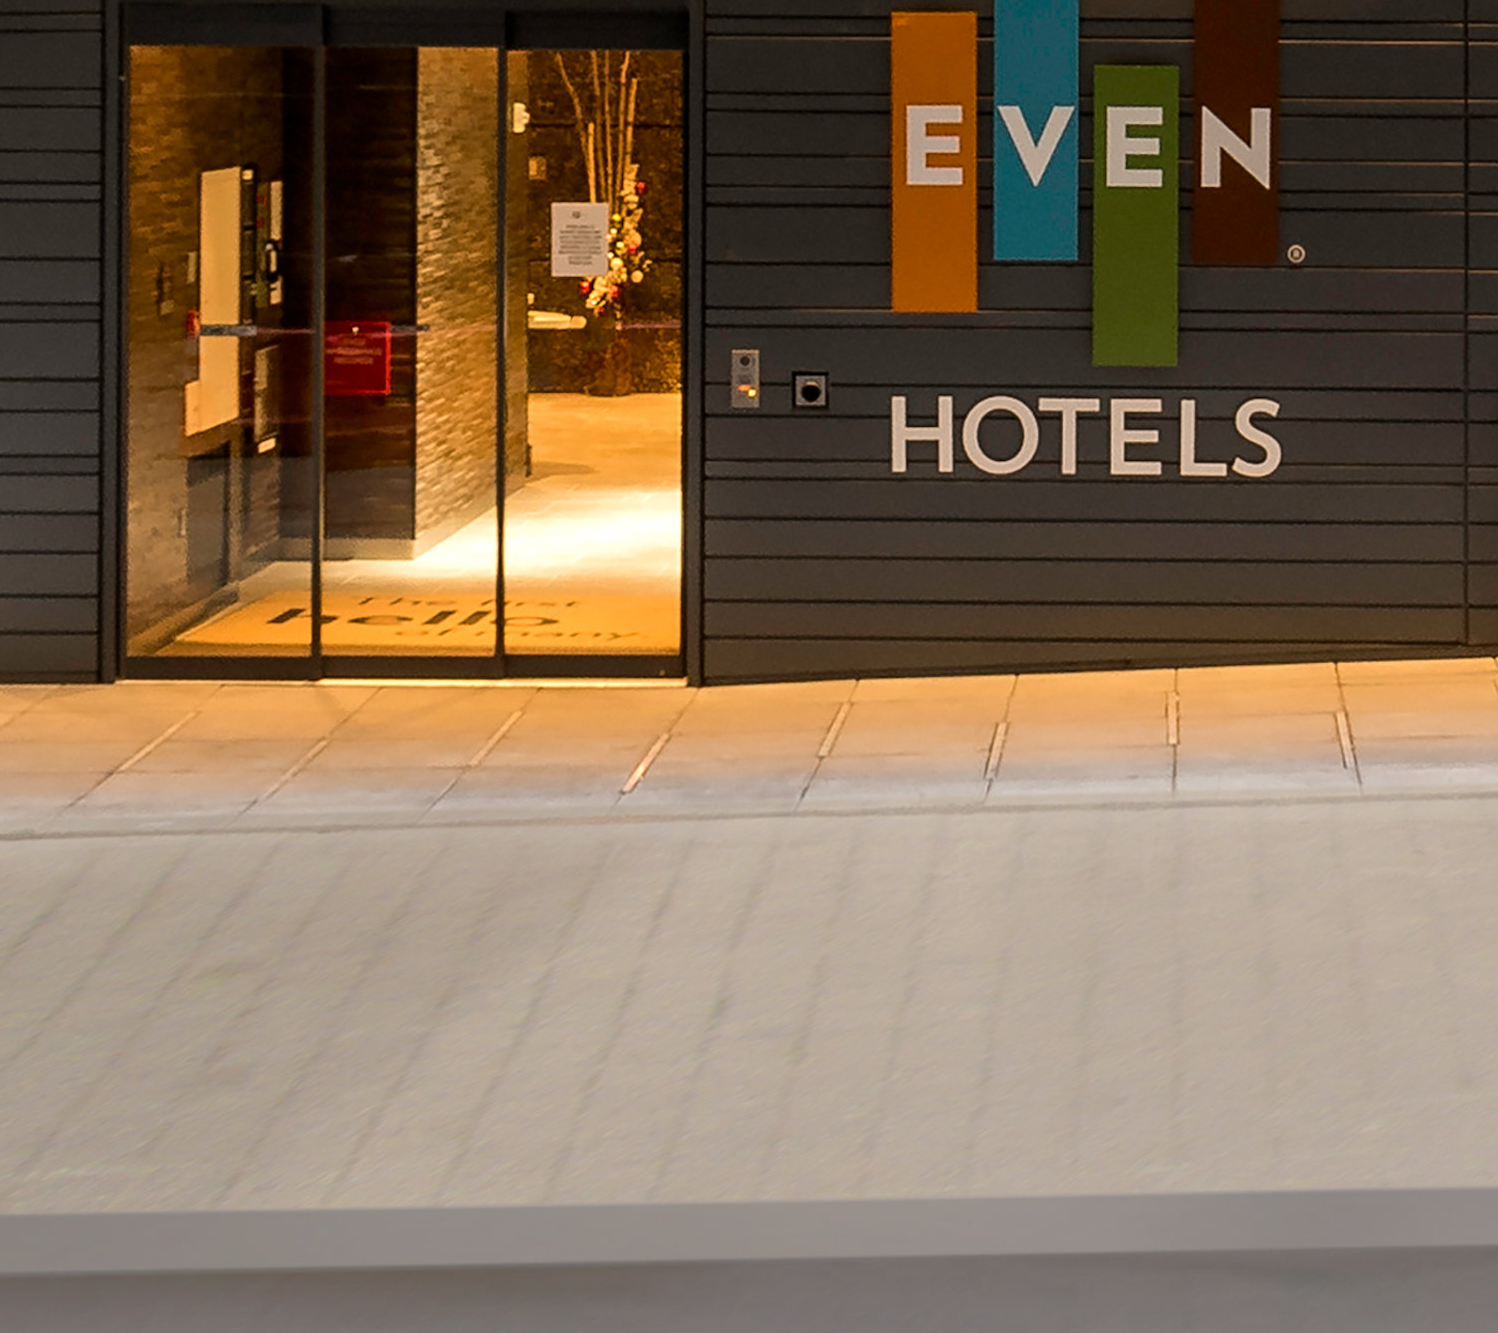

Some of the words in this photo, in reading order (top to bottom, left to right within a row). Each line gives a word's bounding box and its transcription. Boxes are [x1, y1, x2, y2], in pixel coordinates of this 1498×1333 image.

[905, 104, 1272, 190] EVEN
[890, 395, 1282, 478] HOTELS
[266, 608, 560, 627] hello
